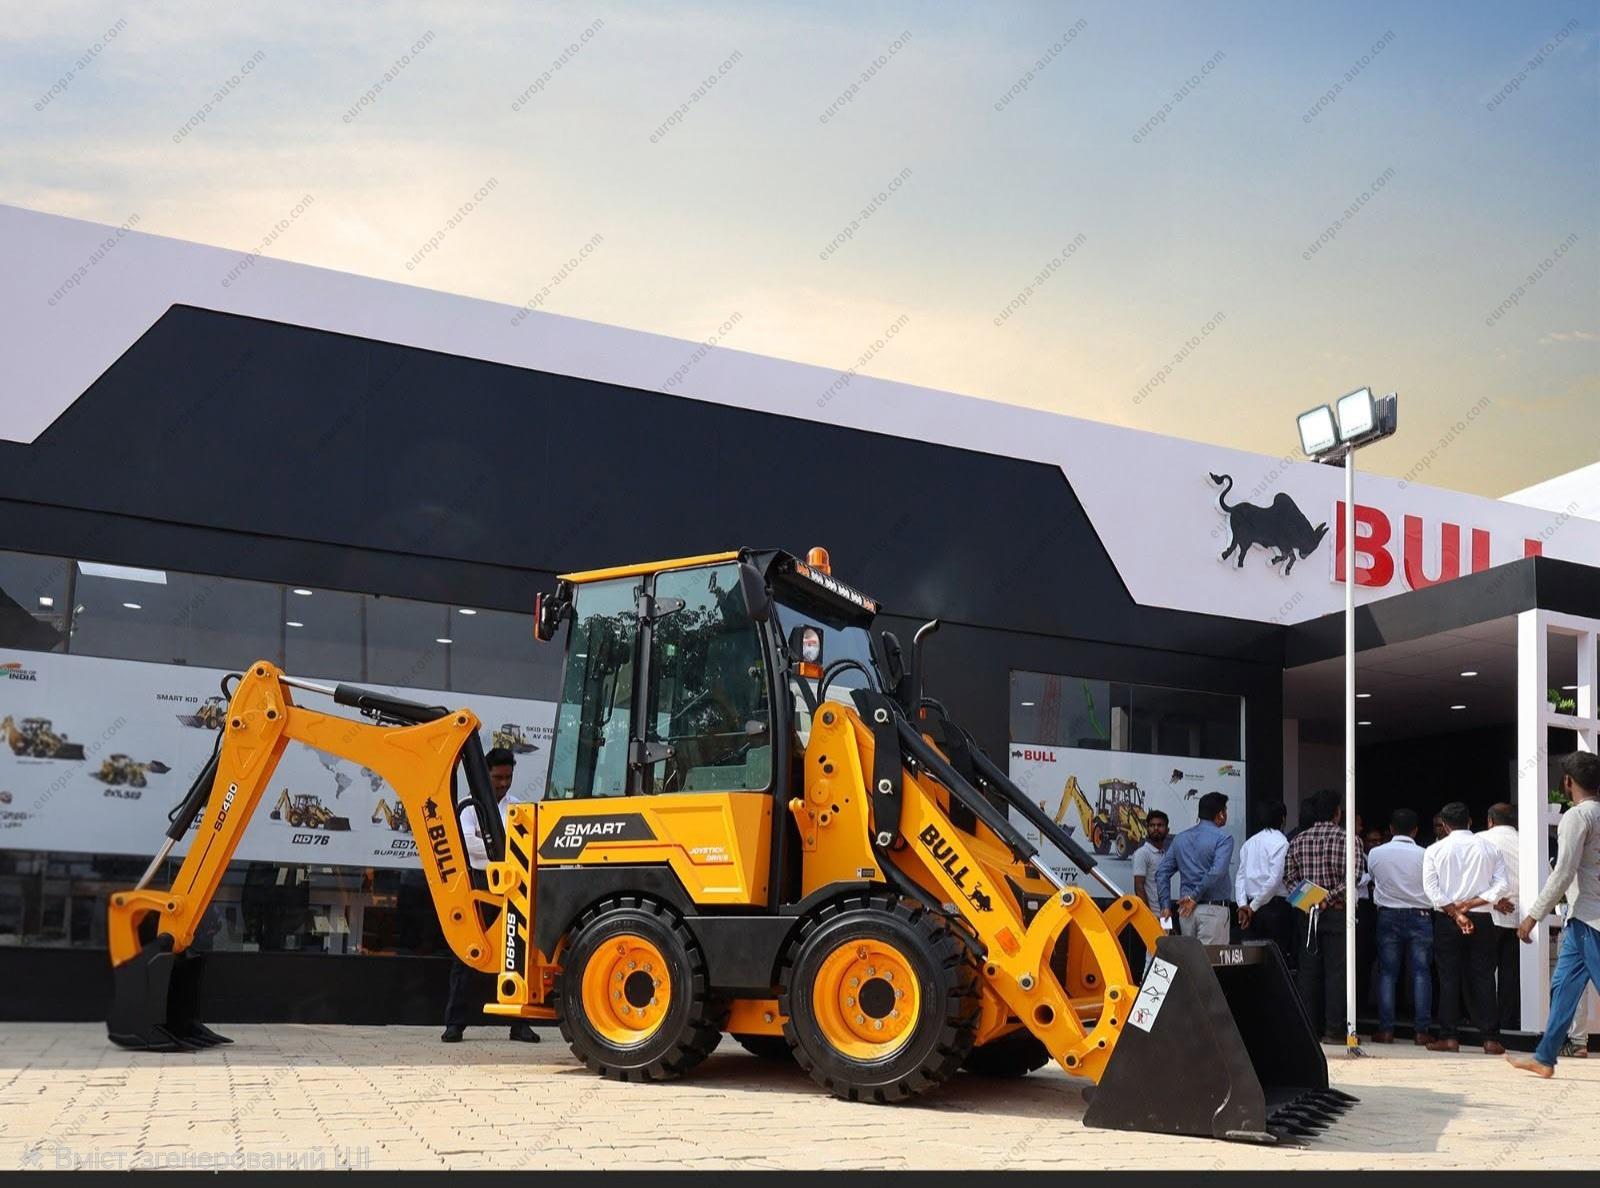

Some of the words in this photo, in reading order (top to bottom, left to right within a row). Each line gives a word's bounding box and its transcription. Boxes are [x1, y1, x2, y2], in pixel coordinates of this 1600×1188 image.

[1335, 500, 1542, 591] BU
[9, 673, 37, 682] INDIA
[156, 694, 183, 702] SMART
[1024, 750, 1057, 762] BULL
[214, 782, 238, 832] SD490
[554, 836, 582, 848] KID
[564, 822, 626, 836] SMART
[428, 824, 457, 884] BULL
[919, 823, 970, 889] BULL
[505, 912, 516, 970] SD490
